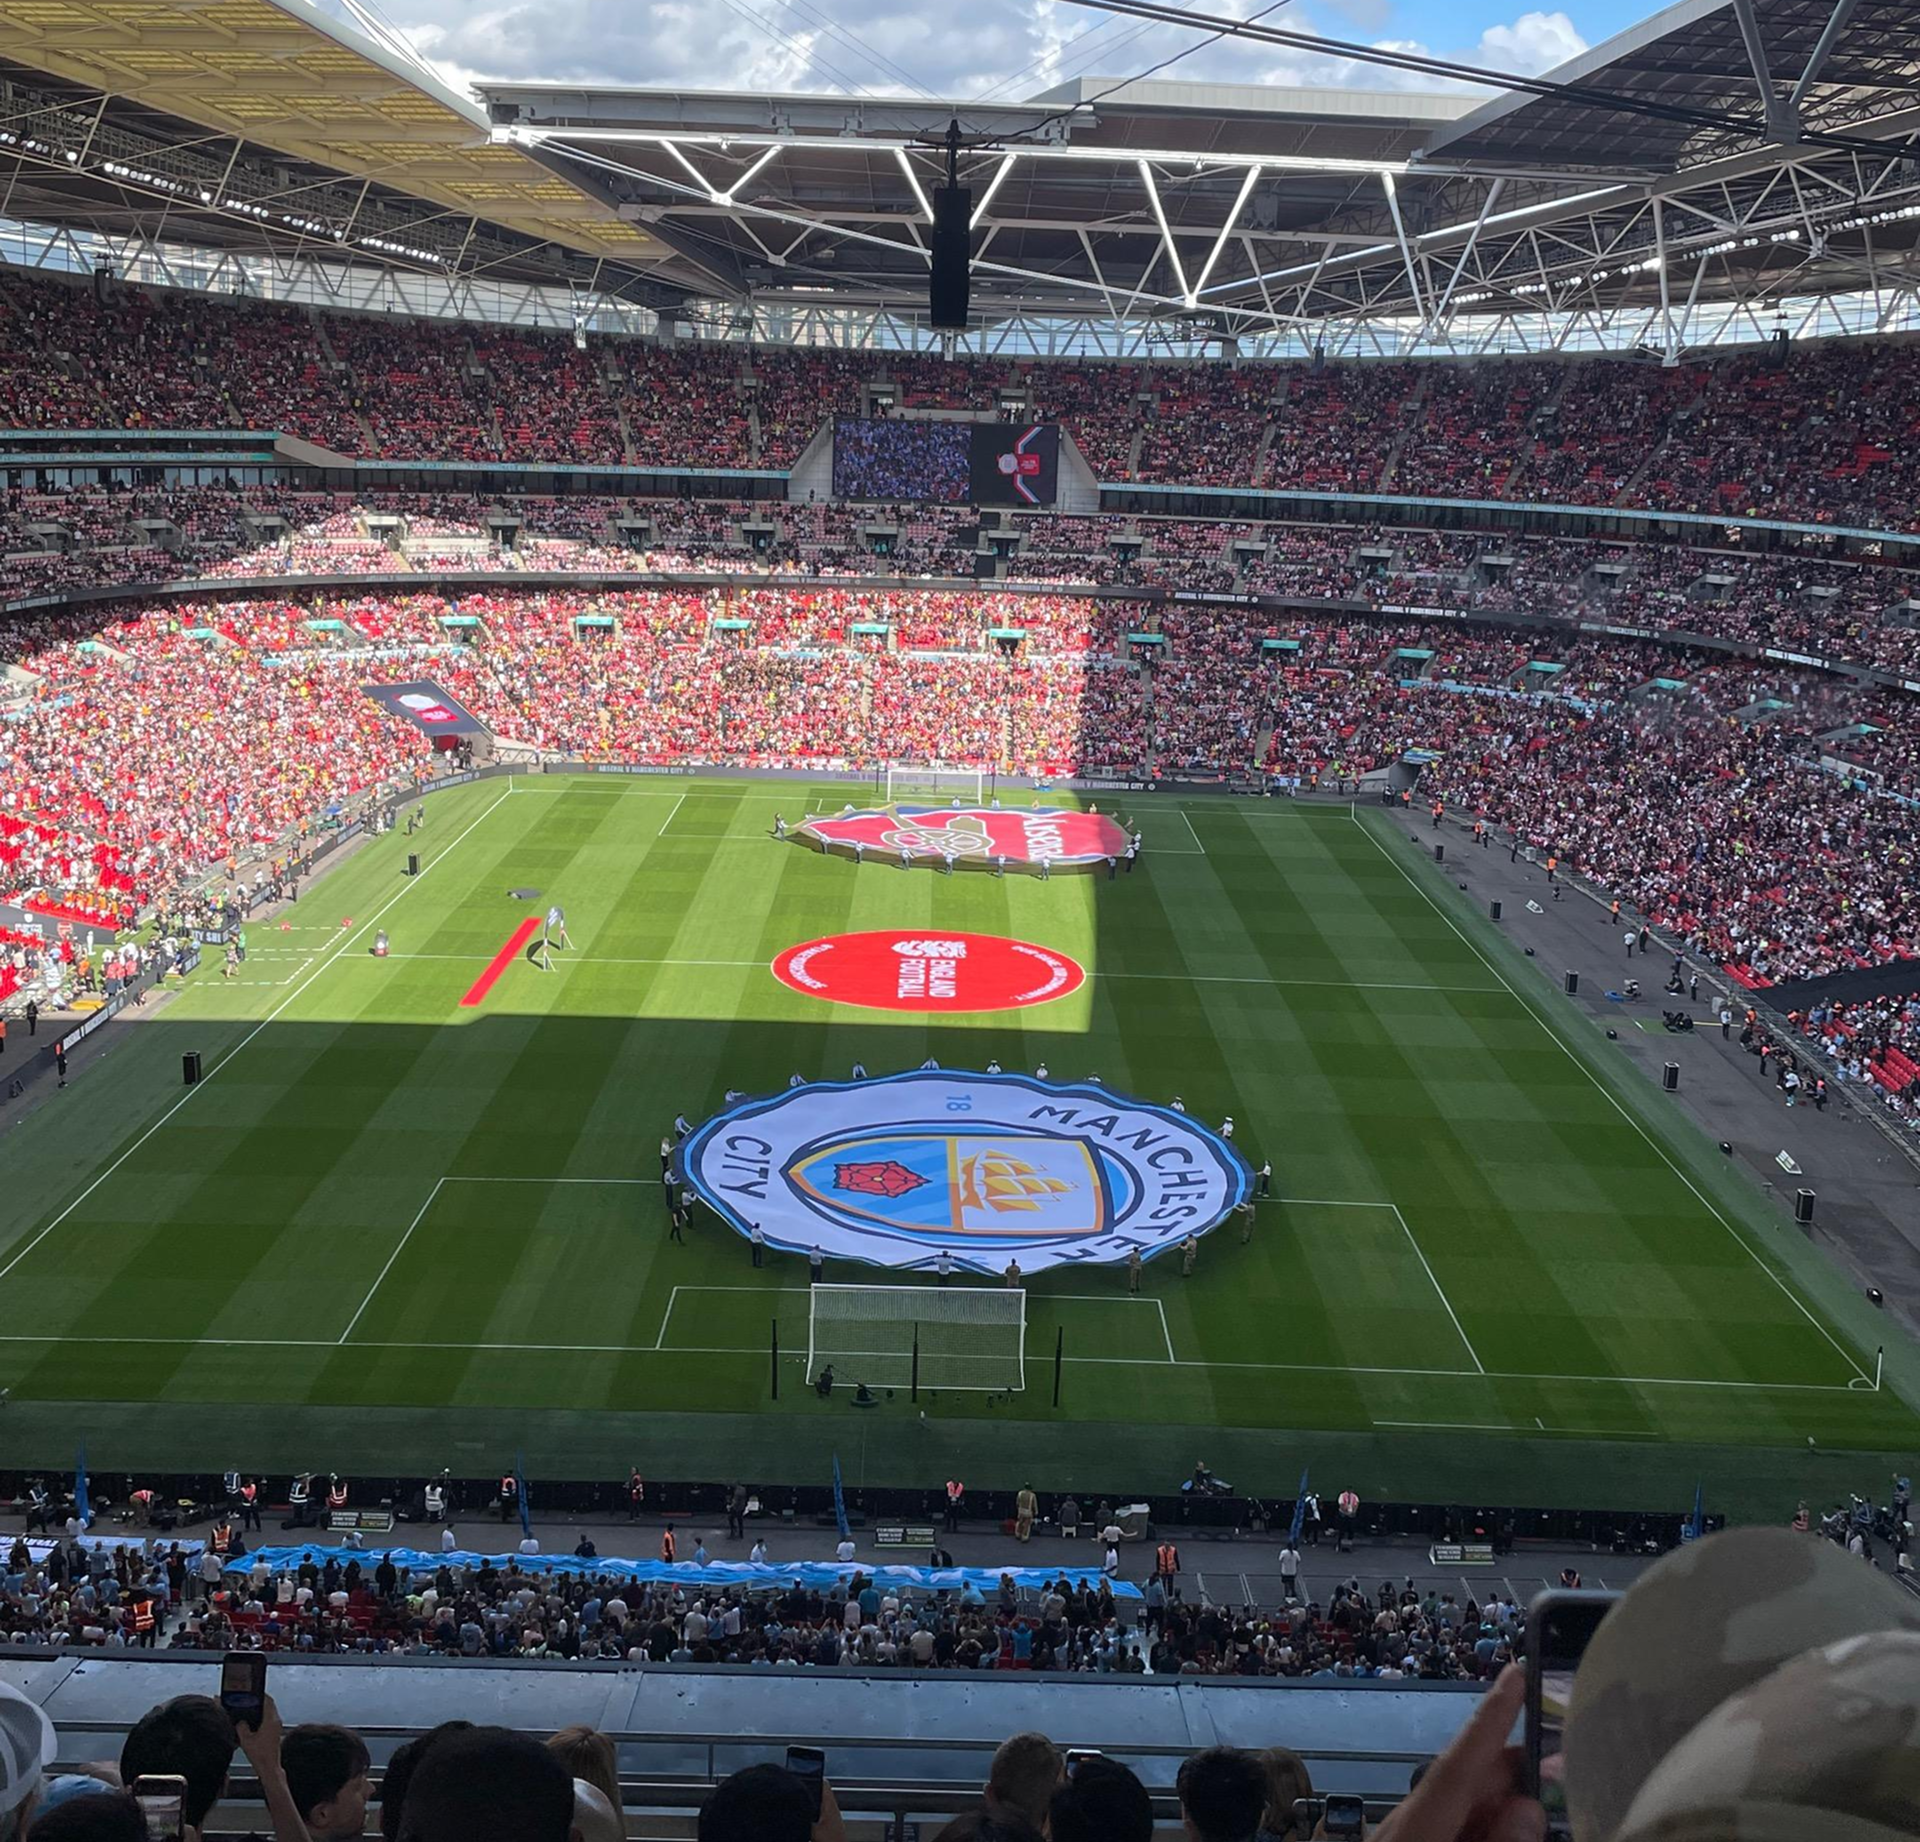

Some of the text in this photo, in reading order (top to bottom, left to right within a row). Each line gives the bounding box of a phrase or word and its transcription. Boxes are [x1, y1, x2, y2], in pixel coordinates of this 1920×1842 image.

[1130, 782, 1144, 790] CITY
[897, 958, 926, 998] FOOTBALL
[929, 959, 957, 998] ENGLAND
[946, 1095, 972, 1111] 18
[719, 1136, 773, 1200] CITY
